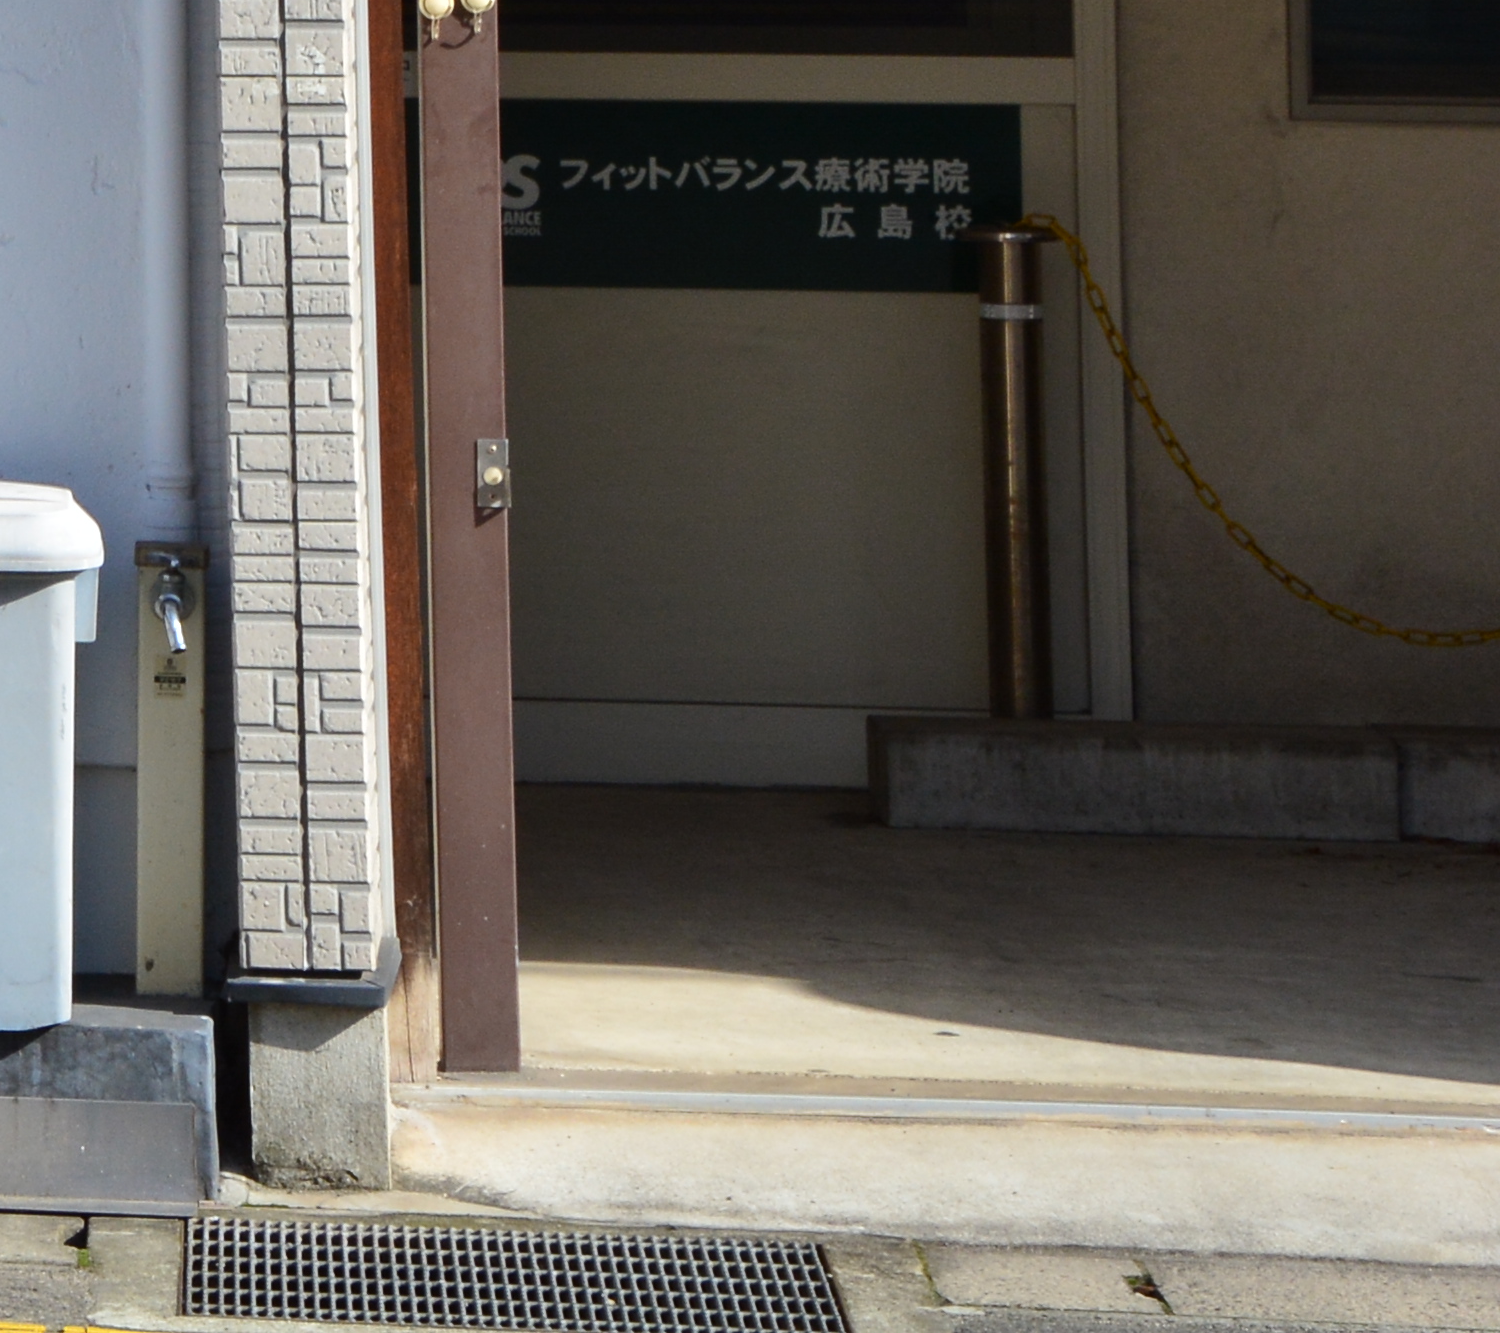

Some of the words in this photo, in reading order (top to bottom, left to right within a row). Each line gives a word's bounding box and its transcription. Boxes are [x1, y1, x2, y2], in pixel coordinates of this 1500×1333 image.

[559, 156, 970, 194] フィットバランス療術学院
[502, 210, 542, 226] ANCE
